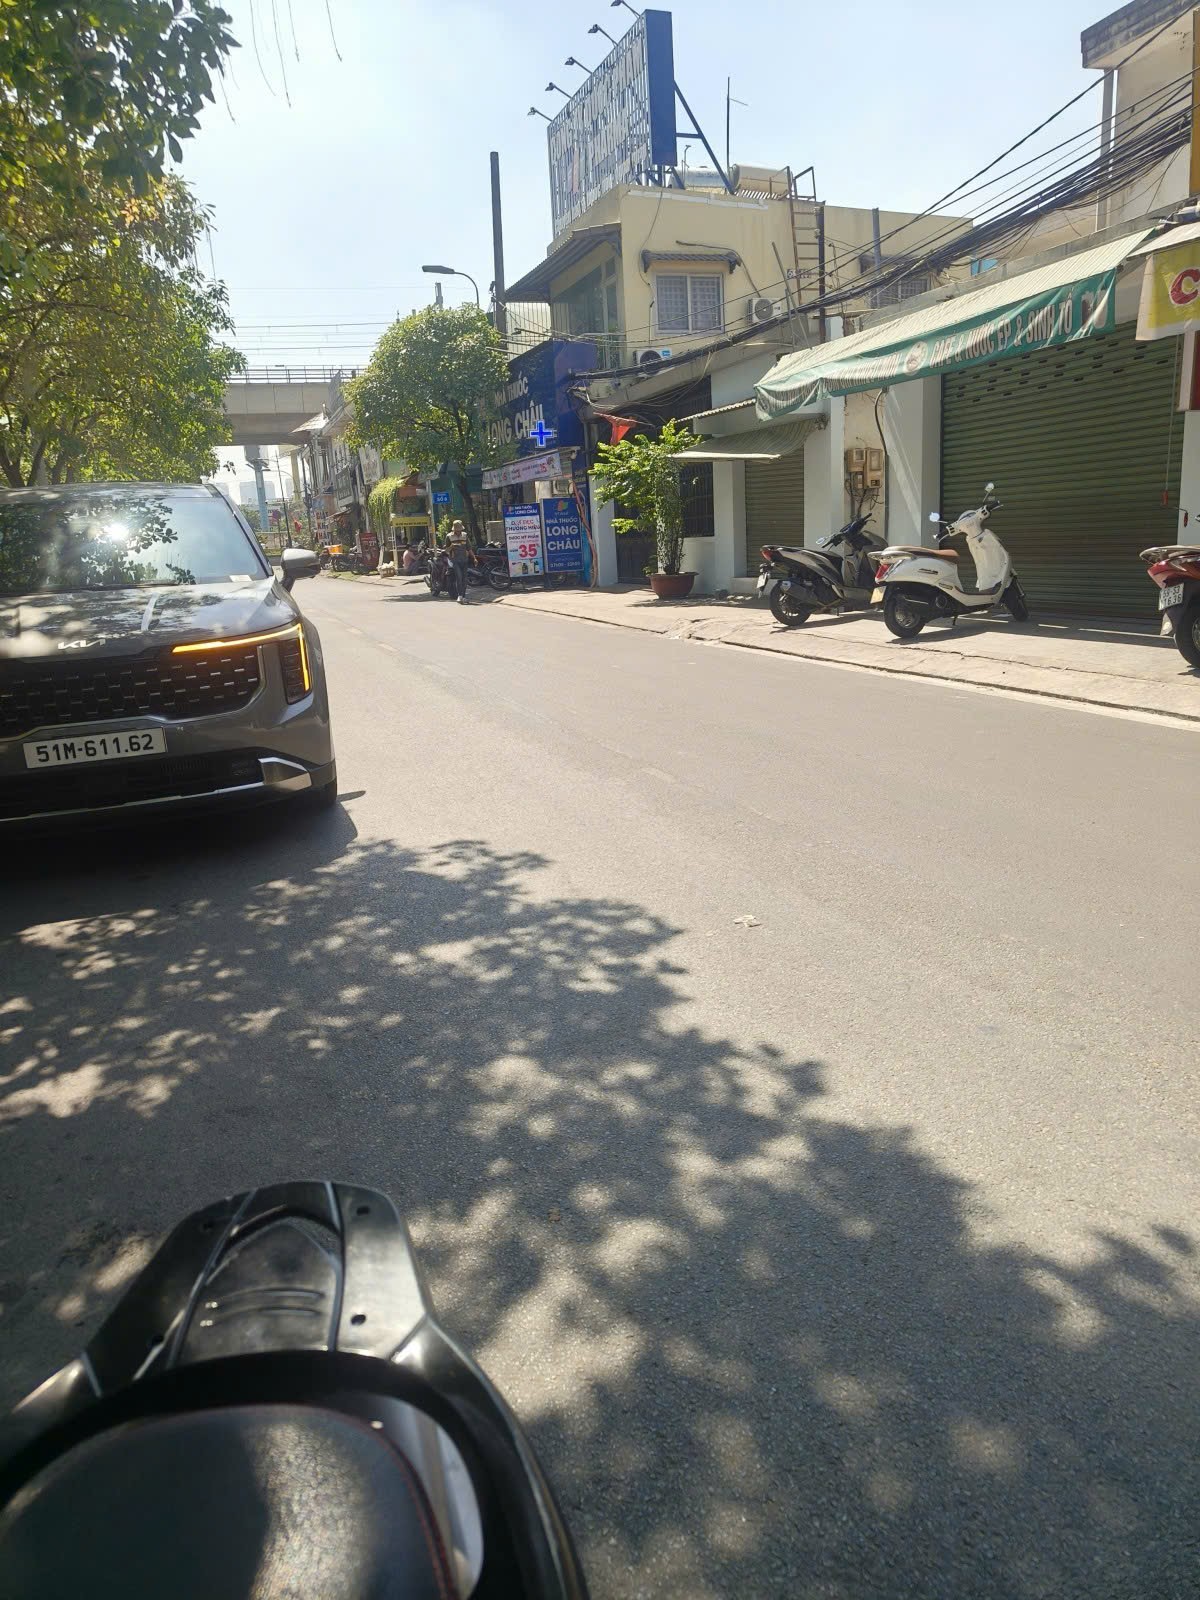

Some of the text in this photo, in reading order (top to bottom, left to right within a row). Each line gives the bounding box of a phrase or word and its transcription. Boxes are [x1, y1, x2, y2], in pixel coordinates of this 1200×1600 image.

[1014, 314, 1024, 347] &
[1026, 303, 1055, 344] SINH
[547, 526, 578, 537] LONG
[548, 538, 580, 550] CHÂU
[36, 734, 154, 763] 51M-611.62
